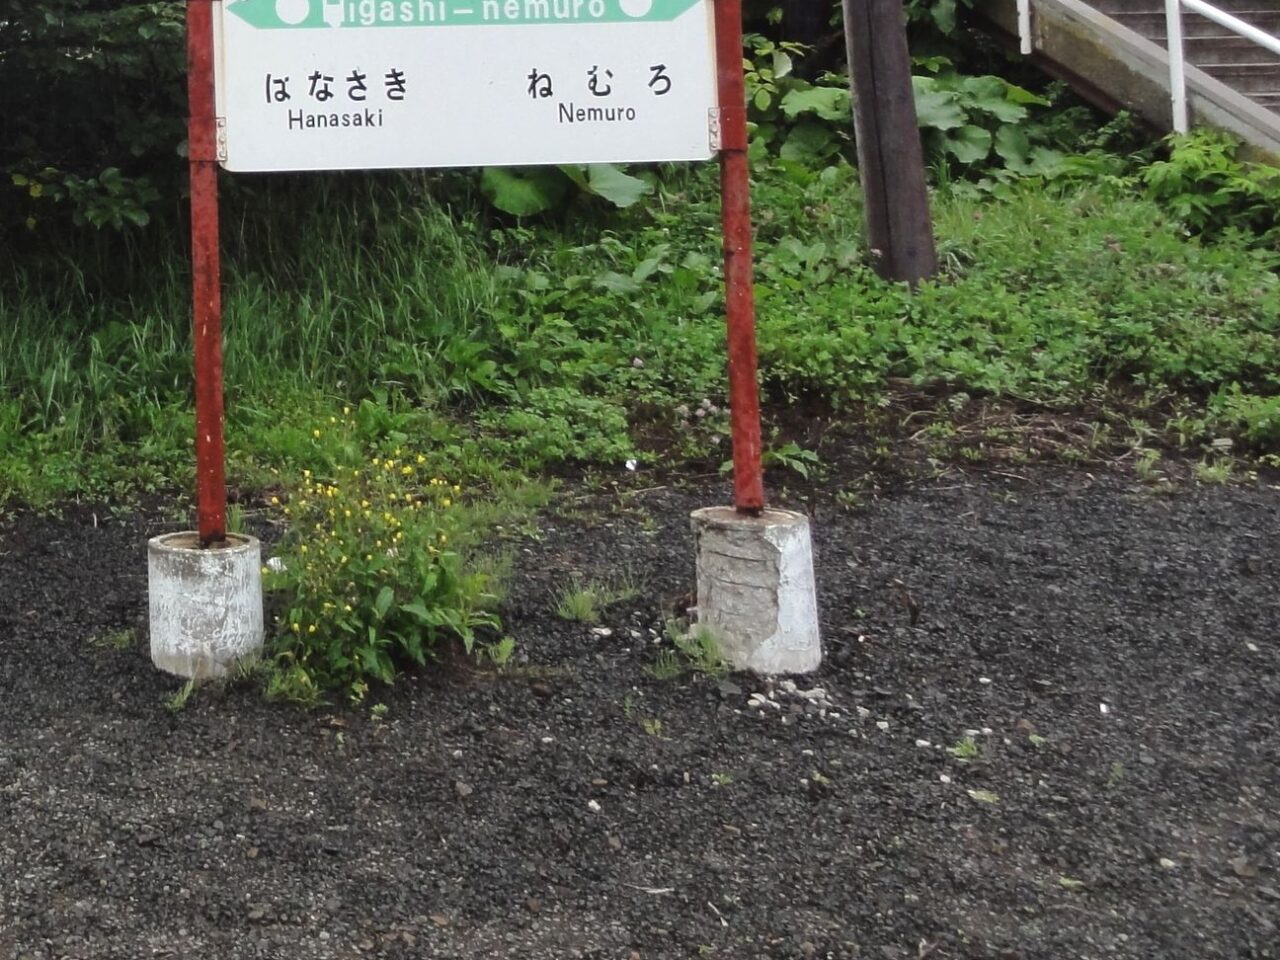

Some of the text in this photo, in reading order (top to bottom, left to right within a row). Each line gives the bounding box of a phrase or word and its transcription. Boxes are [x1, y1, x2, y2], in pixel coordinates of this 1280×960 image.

[265, 68, 409, 103] はなさき
[527, 63, 673, 100] ねむろ
[287, 108, 384, 131] Hanasaki
[557, 102, 637, 124] Nemuro
